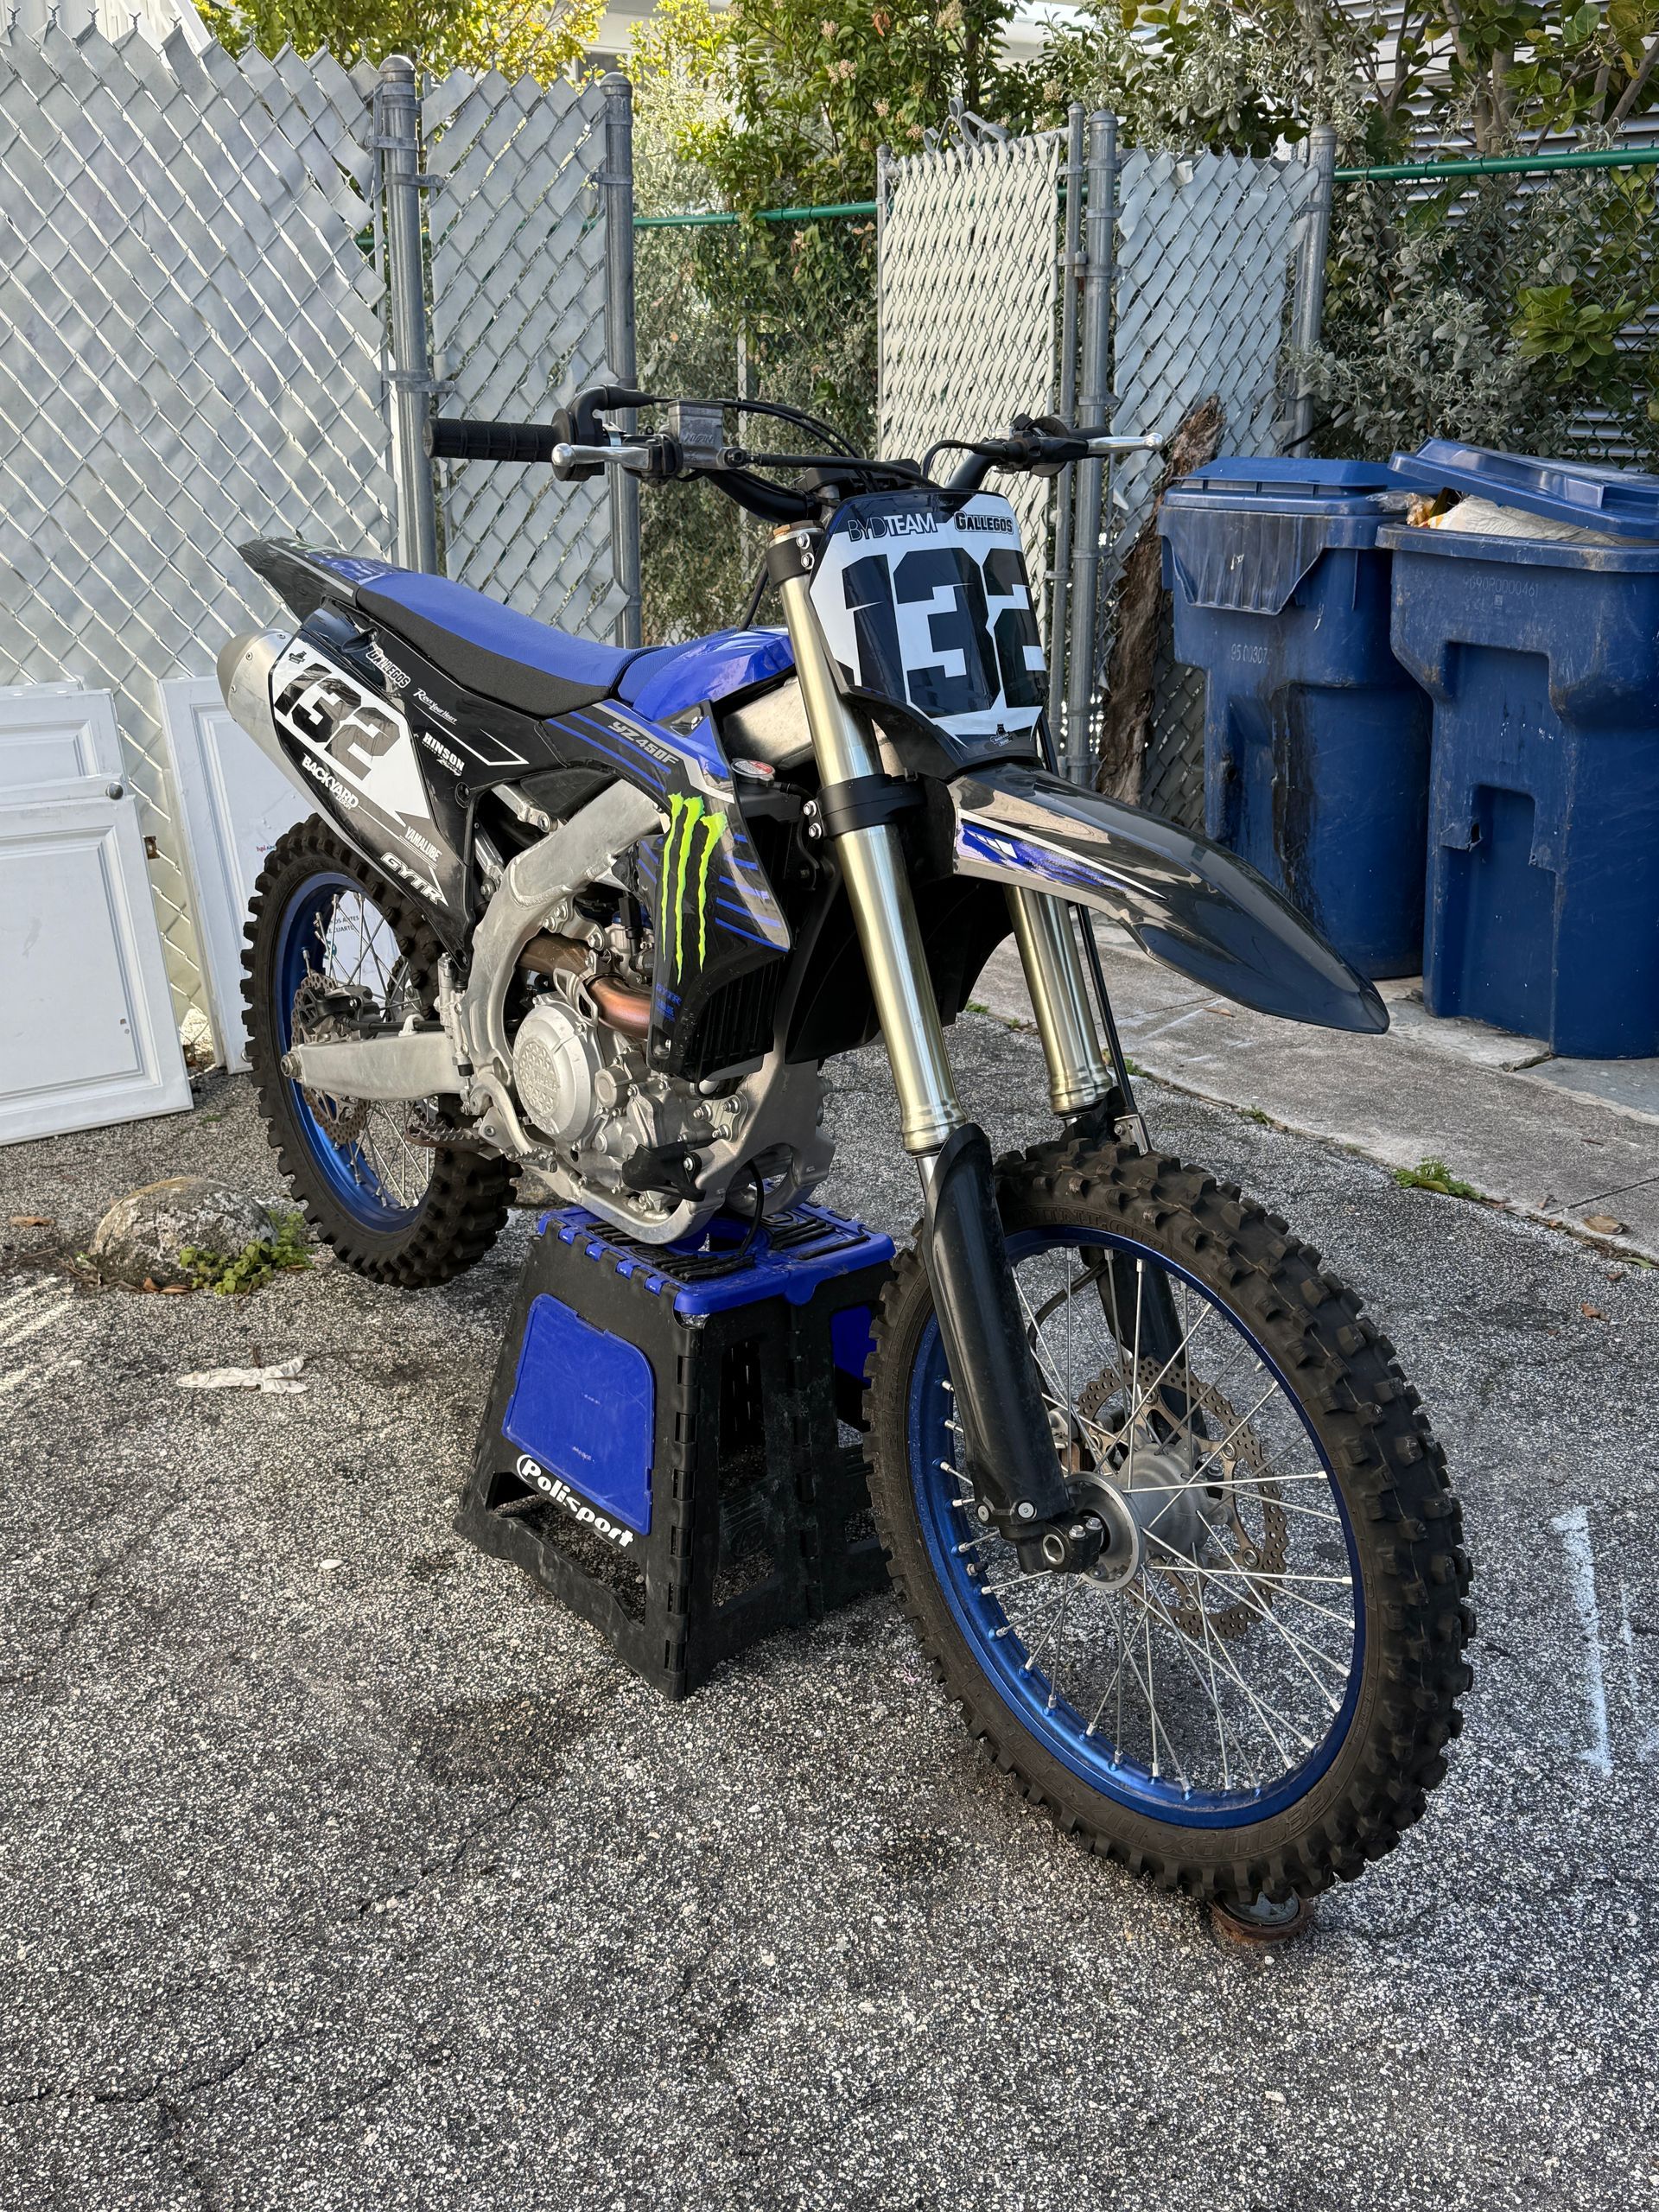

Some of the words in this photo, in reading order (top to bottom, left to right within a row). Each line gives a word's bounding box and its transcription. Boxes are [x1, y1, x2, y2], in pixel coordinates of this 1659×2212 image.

[954, 511, 1014, 535] GALLEGOS
[842, 547, 1047, 719] 132
[365, 647, 411, 689] GALLEGOS
[273, 662, 401, 782] 132
[607, 721, 679, 764] YZ450F
[423, 732, 465, 772] HINSON
[302, 753, 359, 809] BACKYARD
[404, 825, 441, 861] YAMALUBE
[380, 852, 443, 905] GYTR
[516, 1454, 634, 1548] Polisport
